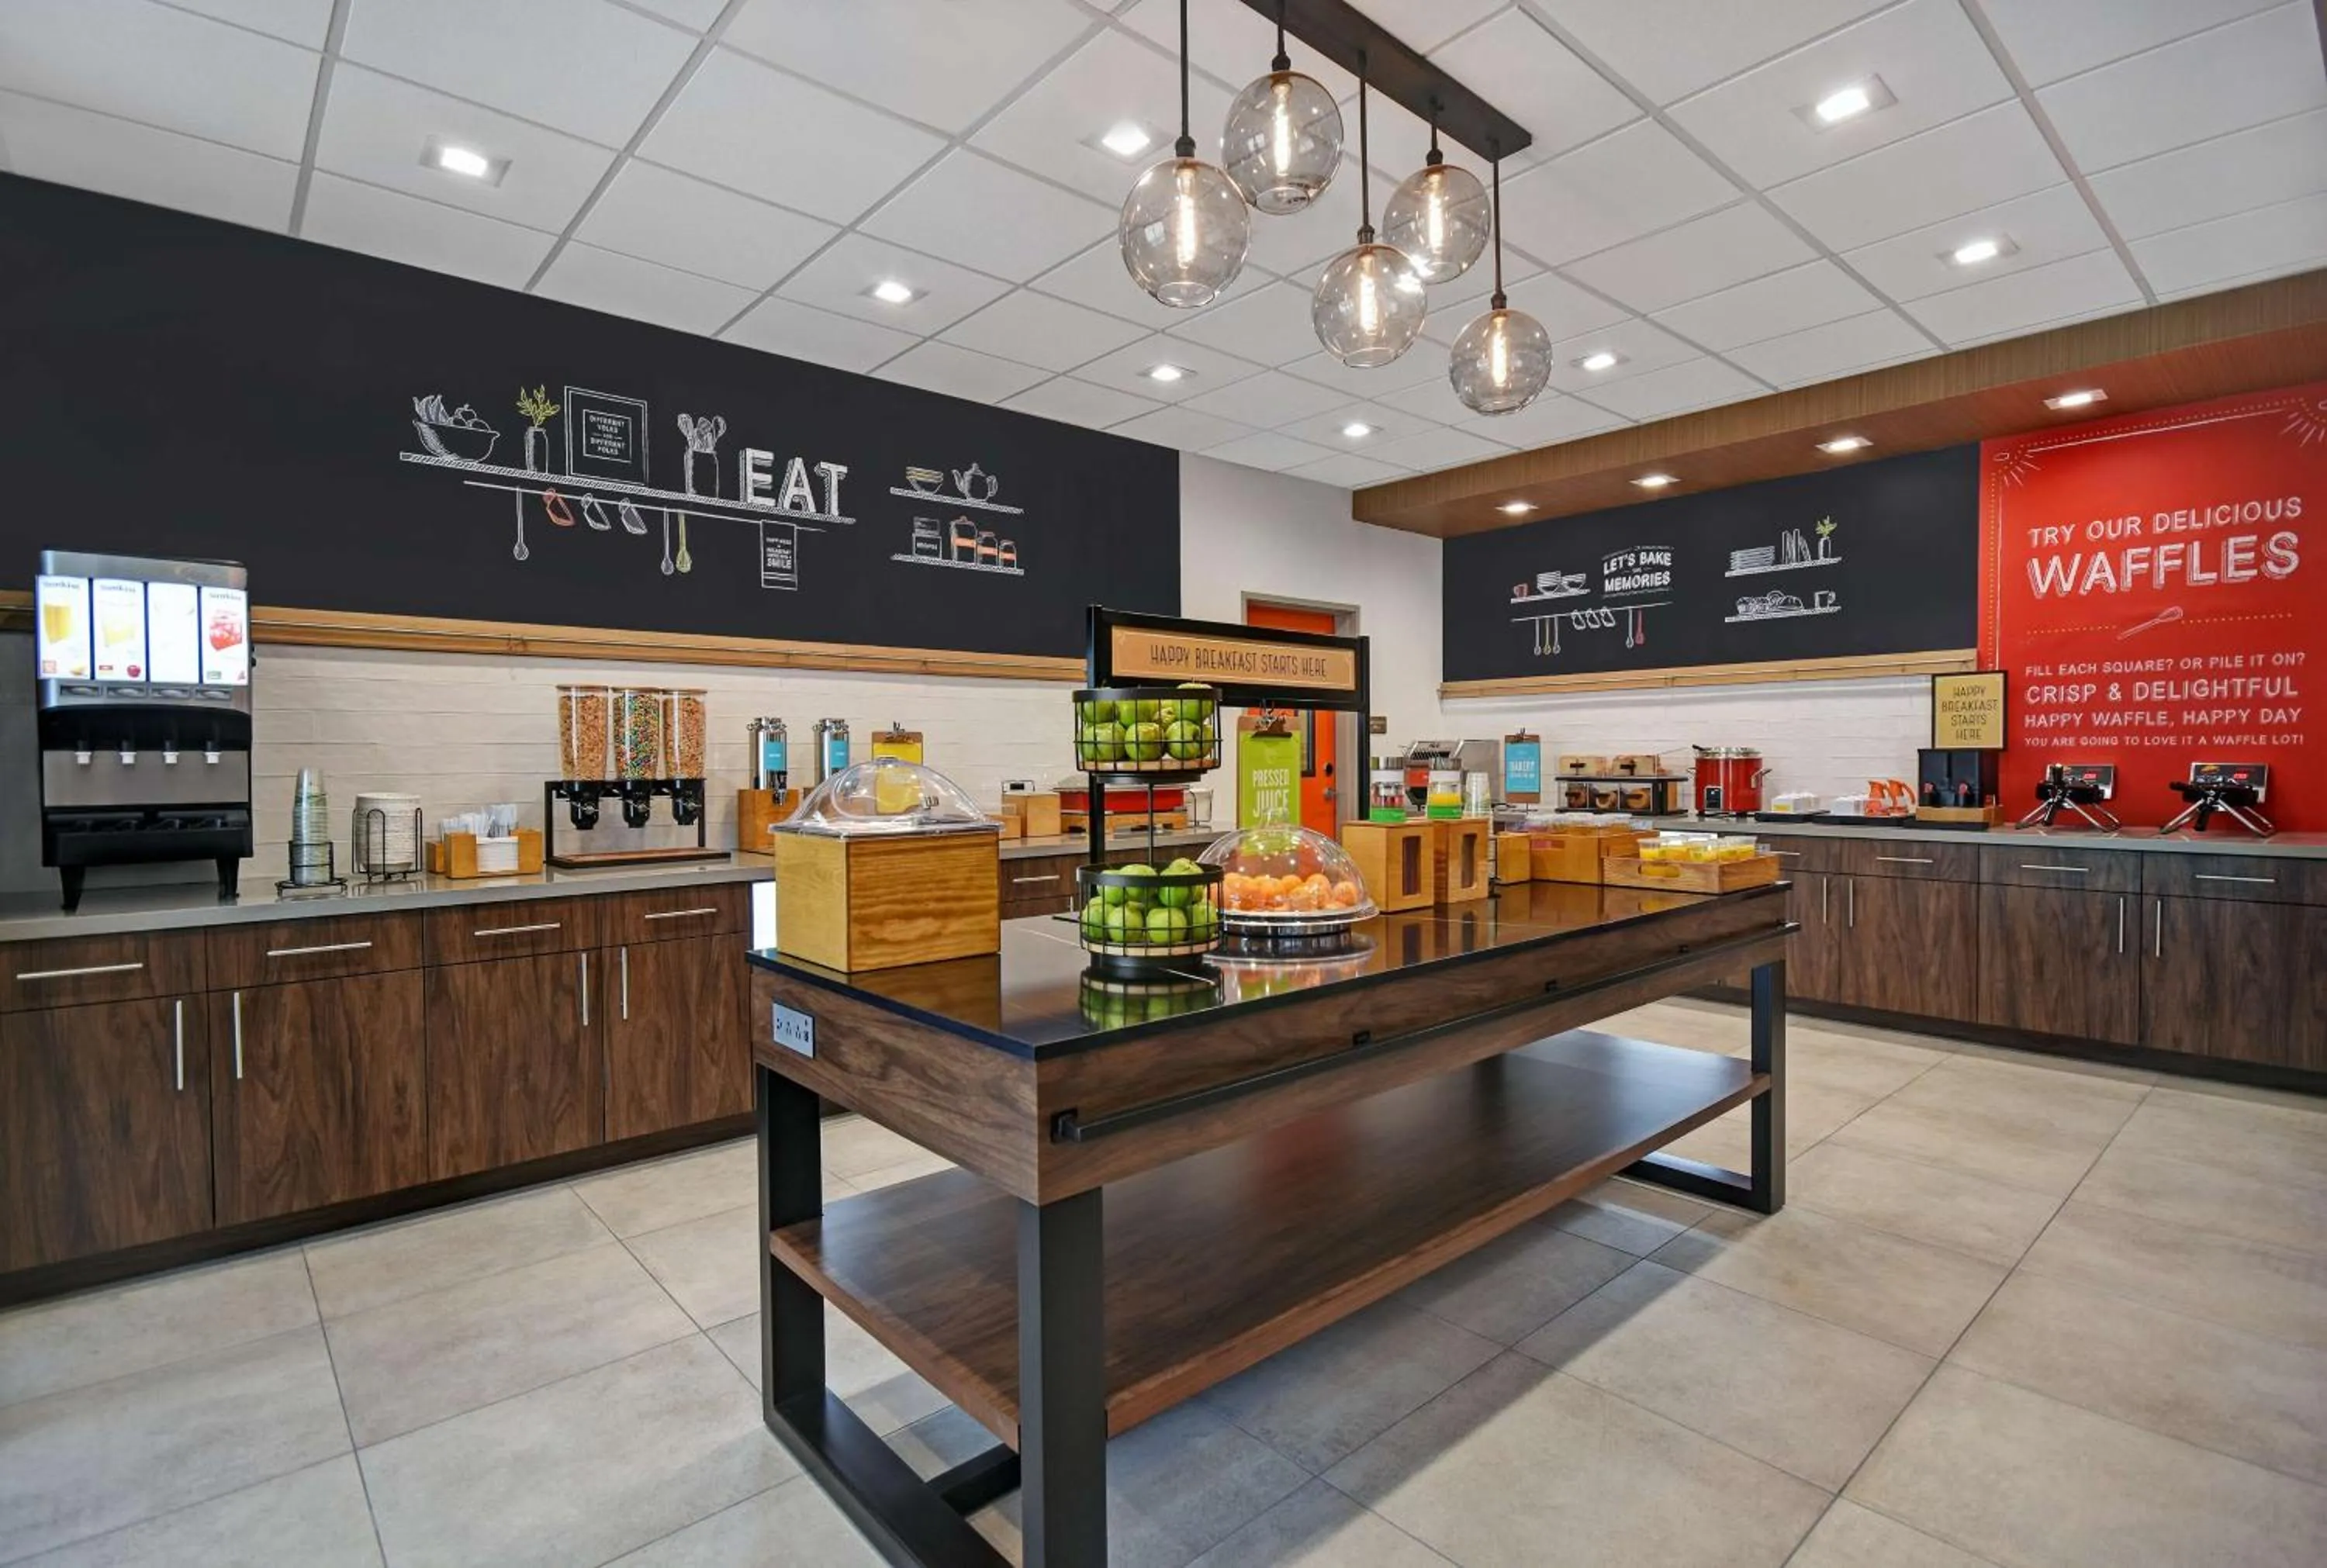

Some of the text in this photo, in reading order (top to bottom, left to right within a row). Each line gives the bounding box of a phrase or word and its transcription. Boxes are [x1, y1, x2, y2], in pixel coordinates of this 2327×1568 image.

[739, 447, 848, 516] EAT
[2027, 496, 2301, 547] TRY OUR DELICIOUS
[1603, 551, 1672, 575] LET'S BAKE
[2027, 531, 2300, 599] WAFFLES
[1604, 571, 1671, 592] MEMORIES
[1150, 644, 1327, 677] HAPPY BREAKFAST STARTS HERE
[2024, 652, 2306, 677] FILL EACH SQUARE? OR PILE IT ON?
[1953, 685, 1986, 697] HAPPY
[2025, 675, 2298, 704] CRISP & DELIGHTFUL
[1941, 699, 1998, 713] BREAKFAST
[1951, 714, 1986, 727] STARTS
[2024, 707, 2302, 729] HAPPY WAFFLE, HAPPY DAY
[1955, 728, 1983, 741] HERE
[2024, 734, 2304, 747] YOU ARE GOING TO LOVE IT A WAFFLE LOT!
[1253, 768, 1290, 788] PRESSED
[1253, 789, 1290, 818] JUICE
